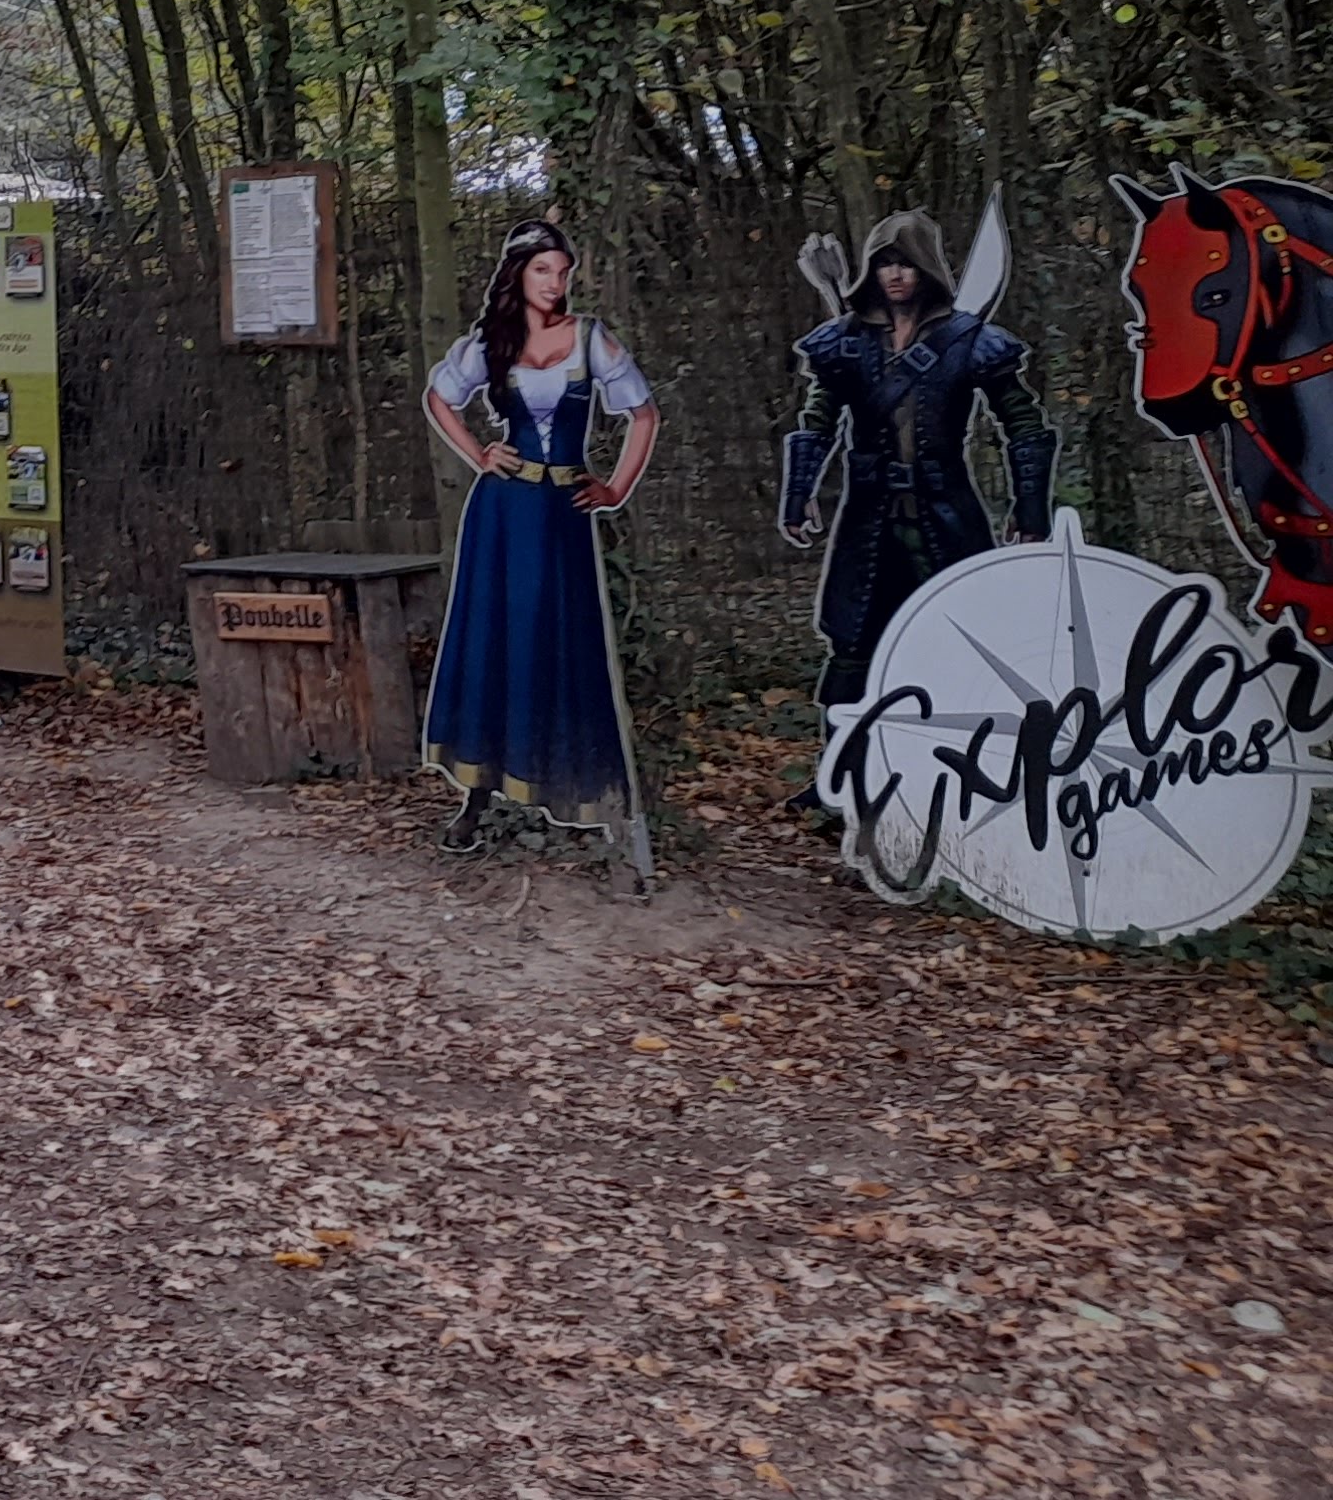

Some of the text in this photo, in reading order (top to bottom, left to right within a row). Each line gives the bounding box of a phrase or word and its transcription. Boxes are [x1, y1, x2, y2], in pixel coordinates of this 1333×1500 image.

[217, 602, 325, 631] Poubelle
[831, 584, 1333, 892] Explor
[1056, 718, 1283, 860] games
